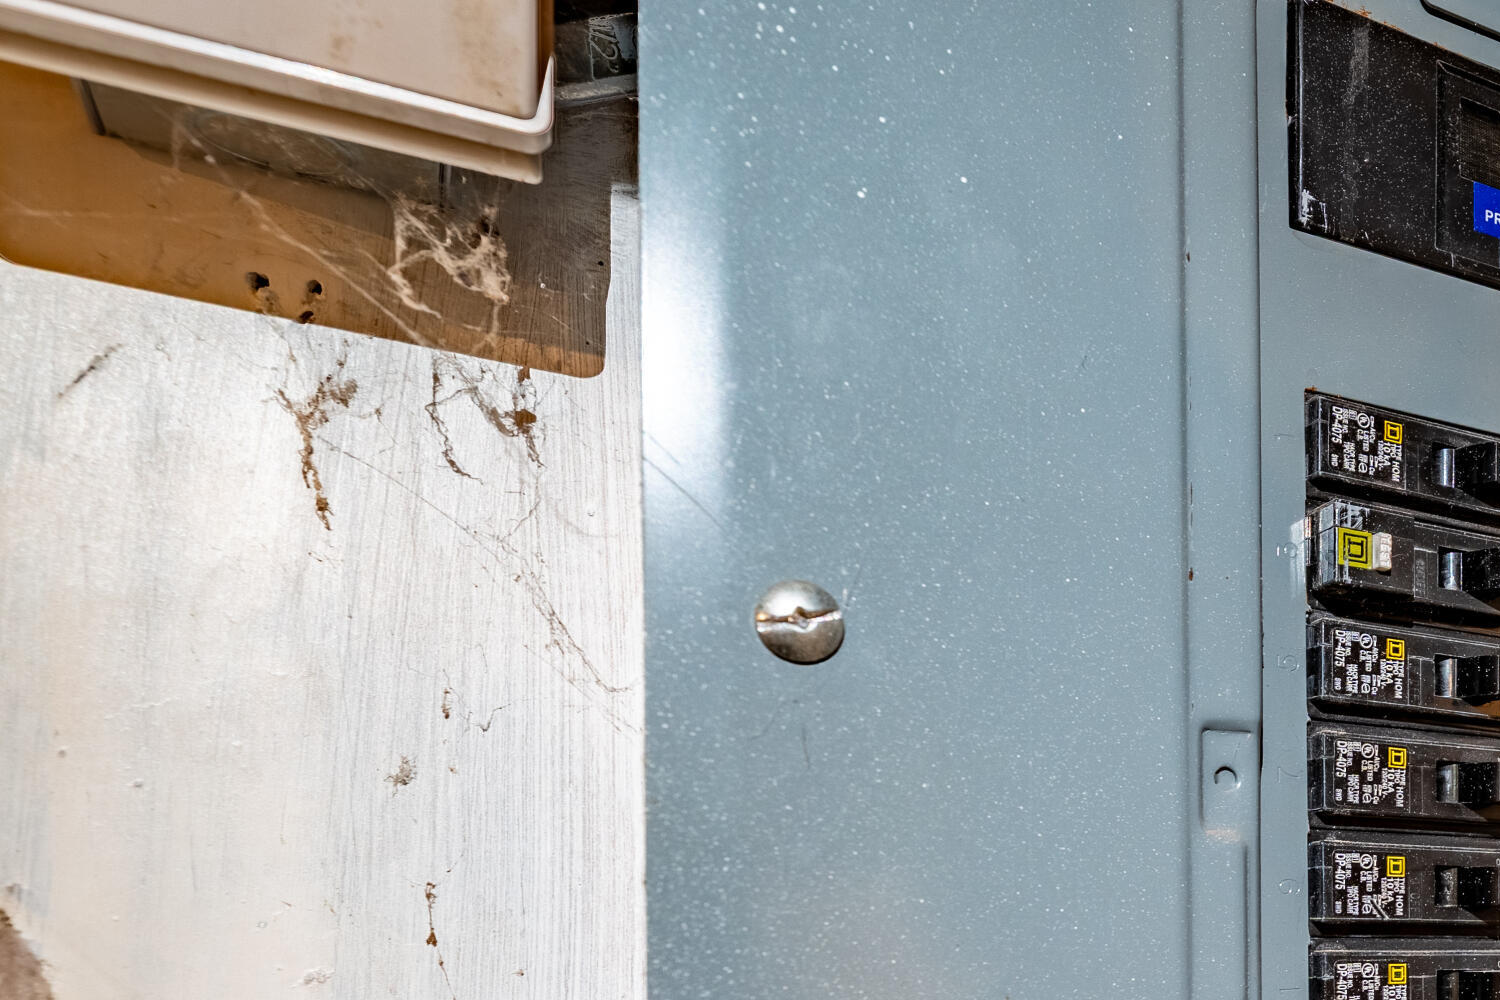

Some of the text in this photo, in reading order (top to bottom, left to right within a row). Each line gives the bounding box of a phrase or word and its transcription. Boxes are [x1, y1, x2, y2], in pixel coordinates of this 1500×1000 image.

[1331, 406, 1342, 444] DP-4075
[1335, 630, 1345, 667] DP-4075
[1386, 660, 1393, 684] 10 kA
[1336, 741, 1346, 777] DP-4075
[1387, 768, 1394, 793] 10 kA
[1335, 853, 1345, 889] DP-4075
[1387, 878, 1394, 901] 10 kA
[1337, 964, 1347, 1000] DP-4075
